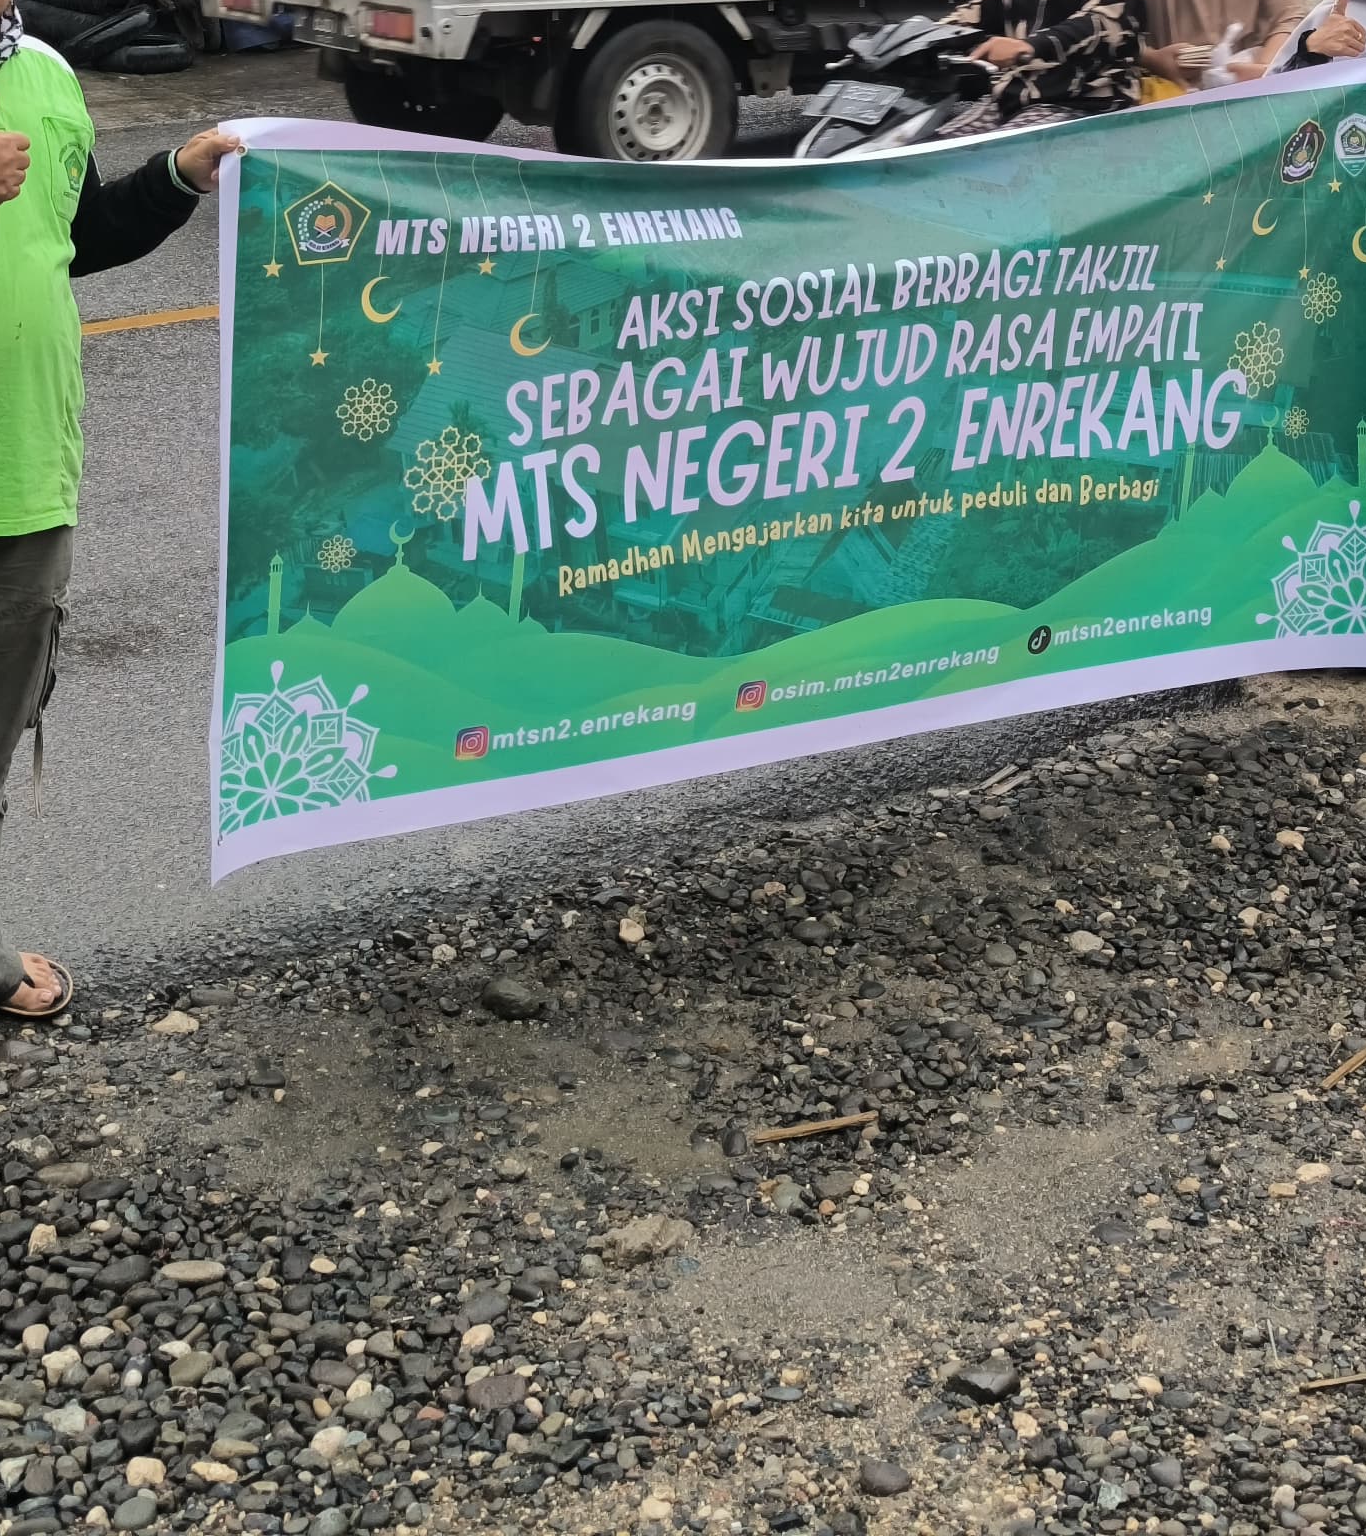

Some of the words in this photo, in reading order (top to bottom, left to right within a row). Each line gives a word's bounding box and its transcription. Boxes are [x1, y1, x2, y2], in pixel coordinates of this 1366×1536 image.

[375, 217, 449, 256] MTS
[459, 213, 566, 254] NEGERI
[574, 213, 596, 249] 2
[605, 206, 742, 247] ENREKANG
[617, 286, 726, 351] AKSI
[733, 262, 879, 334] SOSIAL
[891, 248, 1052, 311] BERBAGI
[1052, 244, 1161, 296] TAKJIL
[506, 345, 749, 448] SEBAGAI
[762, 322, 938, 404] WUJUD
[944, 304, 1055, 380] RASA
[1064, 301, 1205, 368] EMPATI
[462, 442, 603, 562] MTS
[623, 403, 870, 525] NEGERI
[880, 395, 927, 485] 2
[951, 365, 1248, 474] ENREKANG
[559, 543, 676, 598] Ramadhan
[682, 511, 832, 565] Mengajarkan
[840, 494, 885, 530] kita
[891, 489, 954, 522] untuk
[961, 483, 1028, 518] peduli
[1035, 478, 1072, 505] dan
[1079, 474, 1160, 507] Berbagi
[492, 699, 698, 751] mtsn2.enrekang
[770, 644, 1002, 703] osim.mtsn2enrekang
[1054, 604, 1213, 647] mtsn2enrekang
